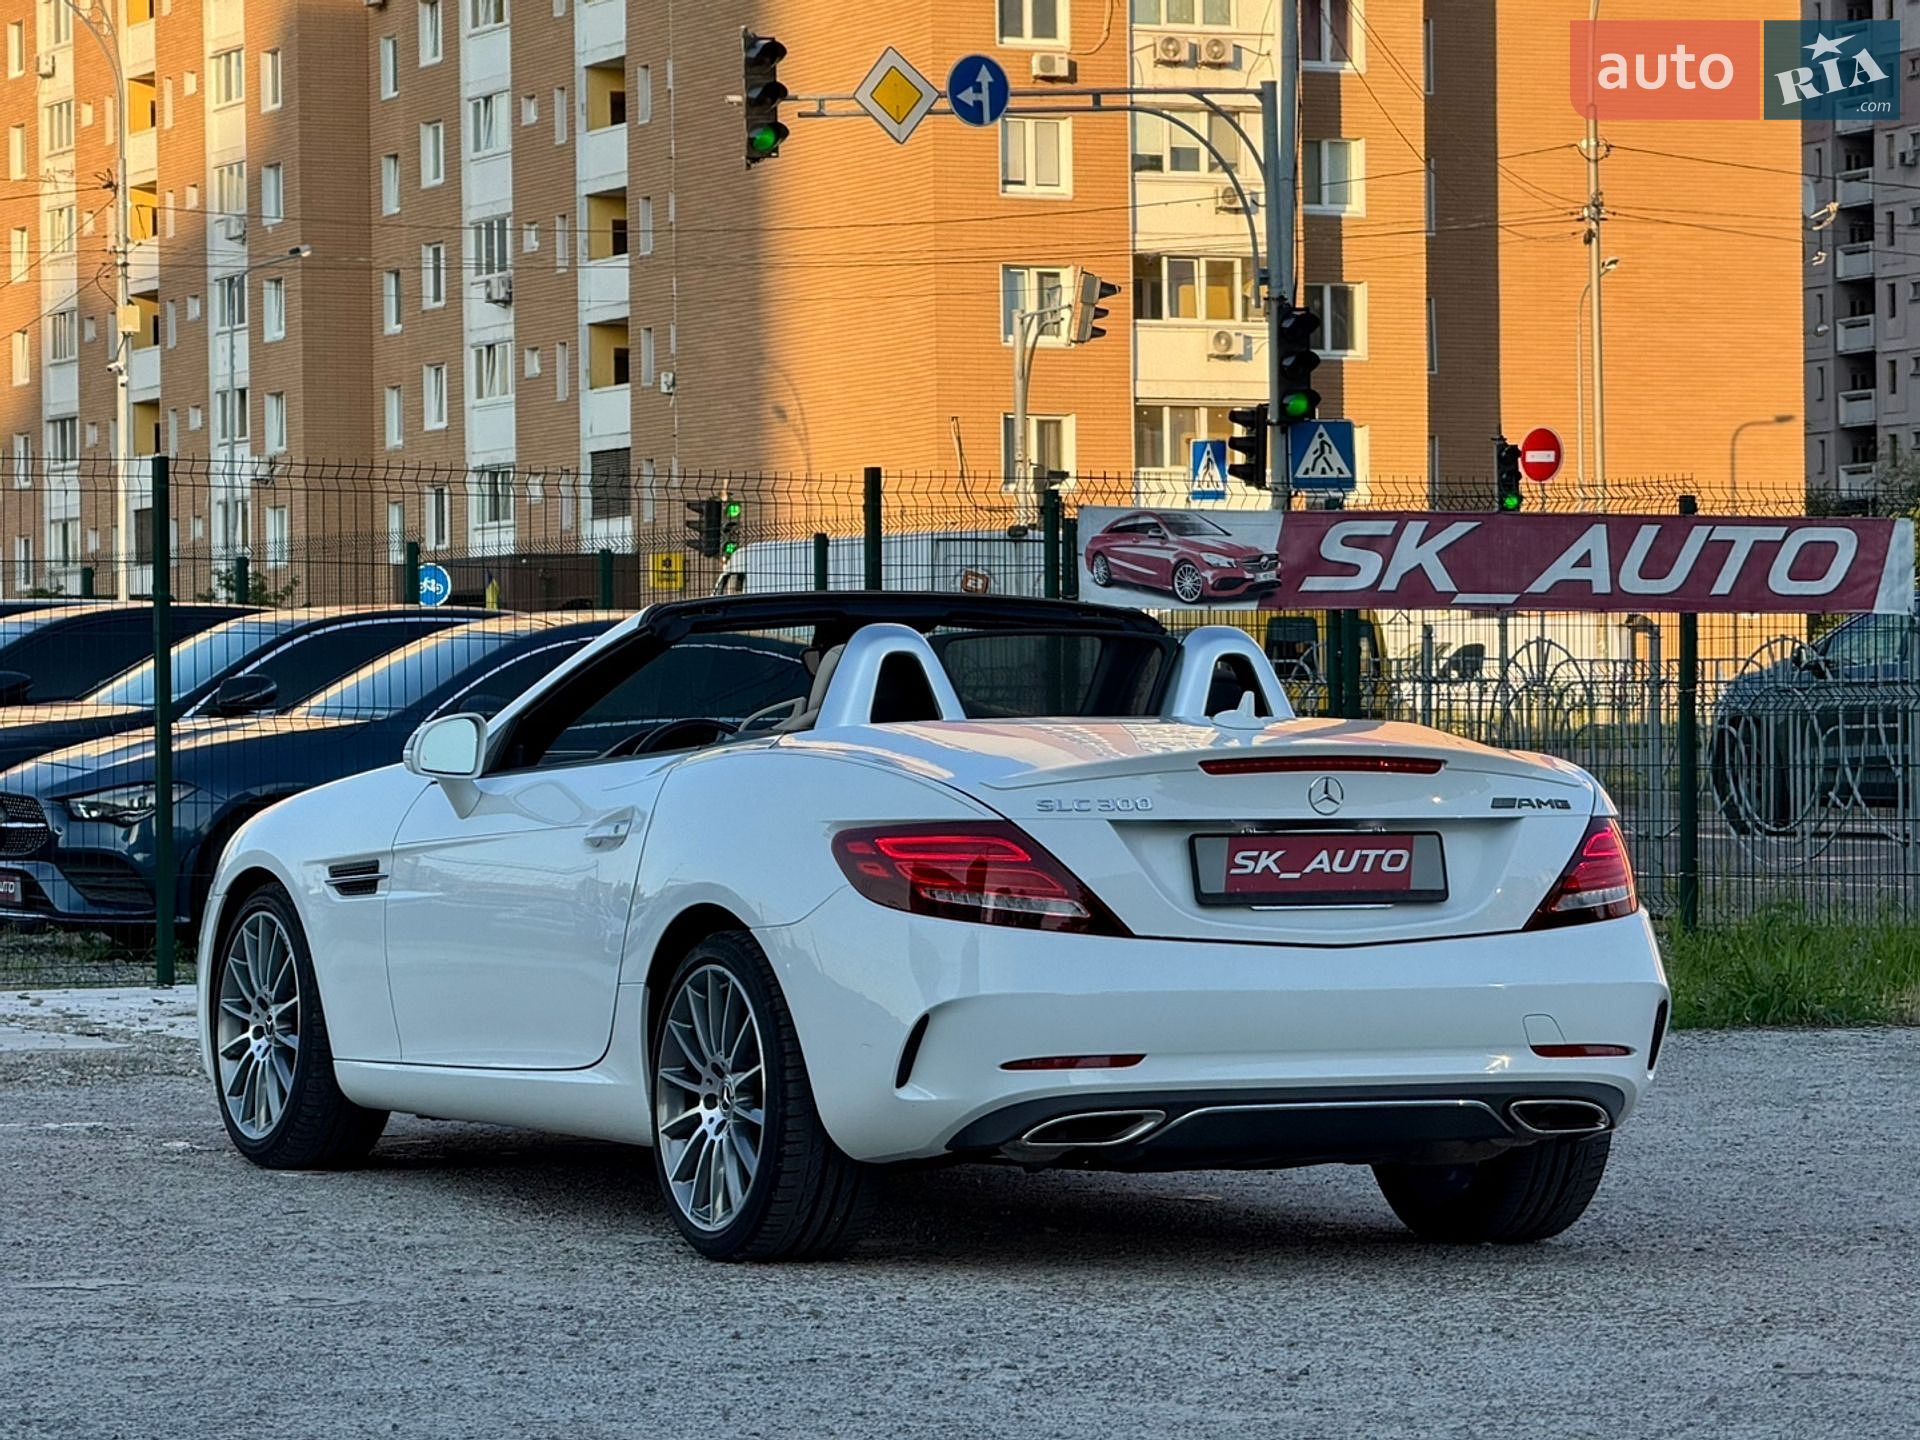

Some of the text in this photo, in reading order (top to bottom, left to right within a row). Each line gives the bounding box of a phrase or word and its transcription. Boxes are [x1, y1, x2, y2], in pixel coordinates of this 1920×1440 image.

[1299, 520, 1858, 604] SK_AUTO
[1036, 797, 1154, 813] SLC 300
[1517, 798, 1571, 809] AMG
[1229, 849, 1410, 879] SK_AUTO
